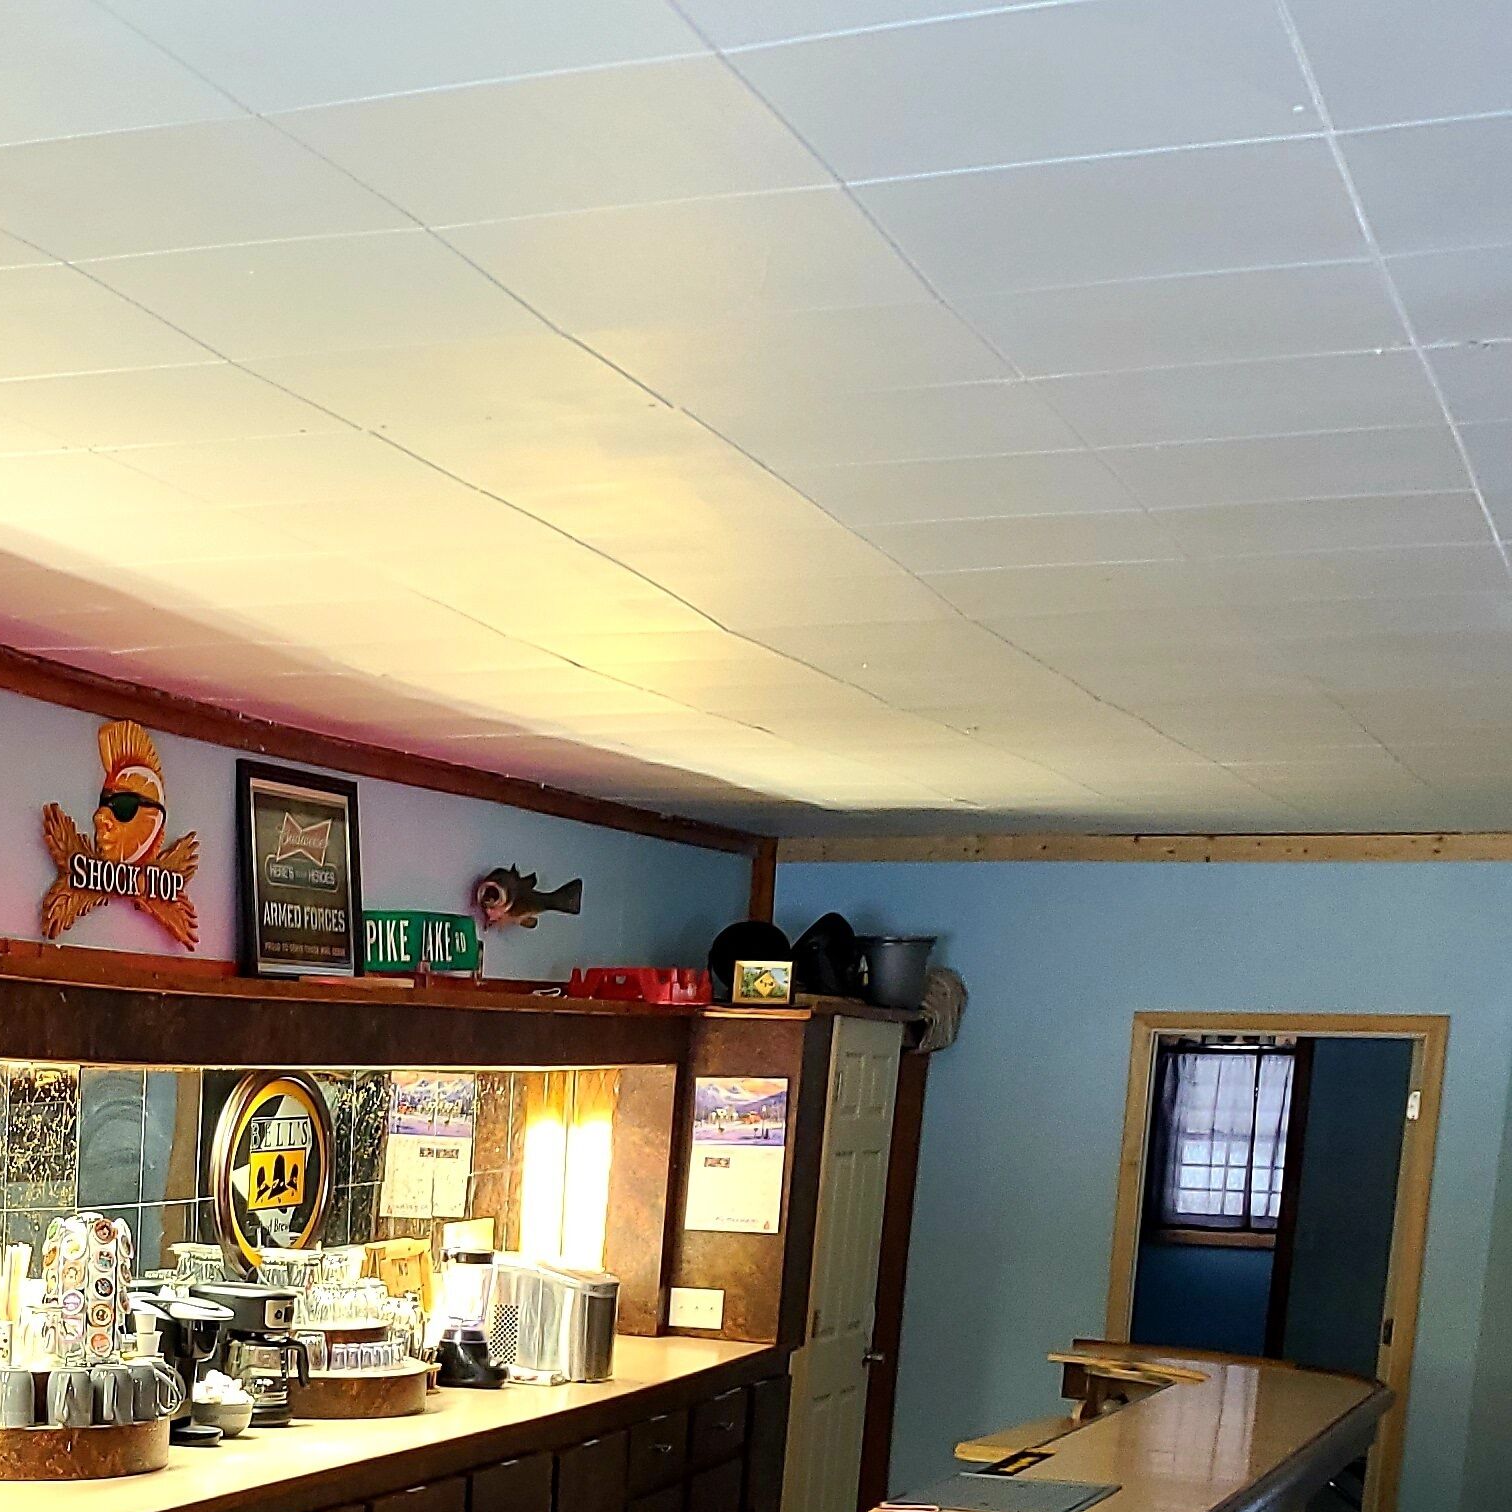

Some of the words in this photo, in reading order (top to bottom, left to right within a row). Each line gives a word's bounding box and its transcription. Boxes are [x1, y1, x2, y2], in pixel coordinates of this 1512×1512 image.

[73, 853, 141, 896] SHOCK
[146, 865, 184, 901] TOP
[263, 900, 302, 928] ARMED
[304, 906, 346, 933] FORCES
[366, 919, 411, 963] PIKE
[251, 1120, 308, 1149] BELL'S
